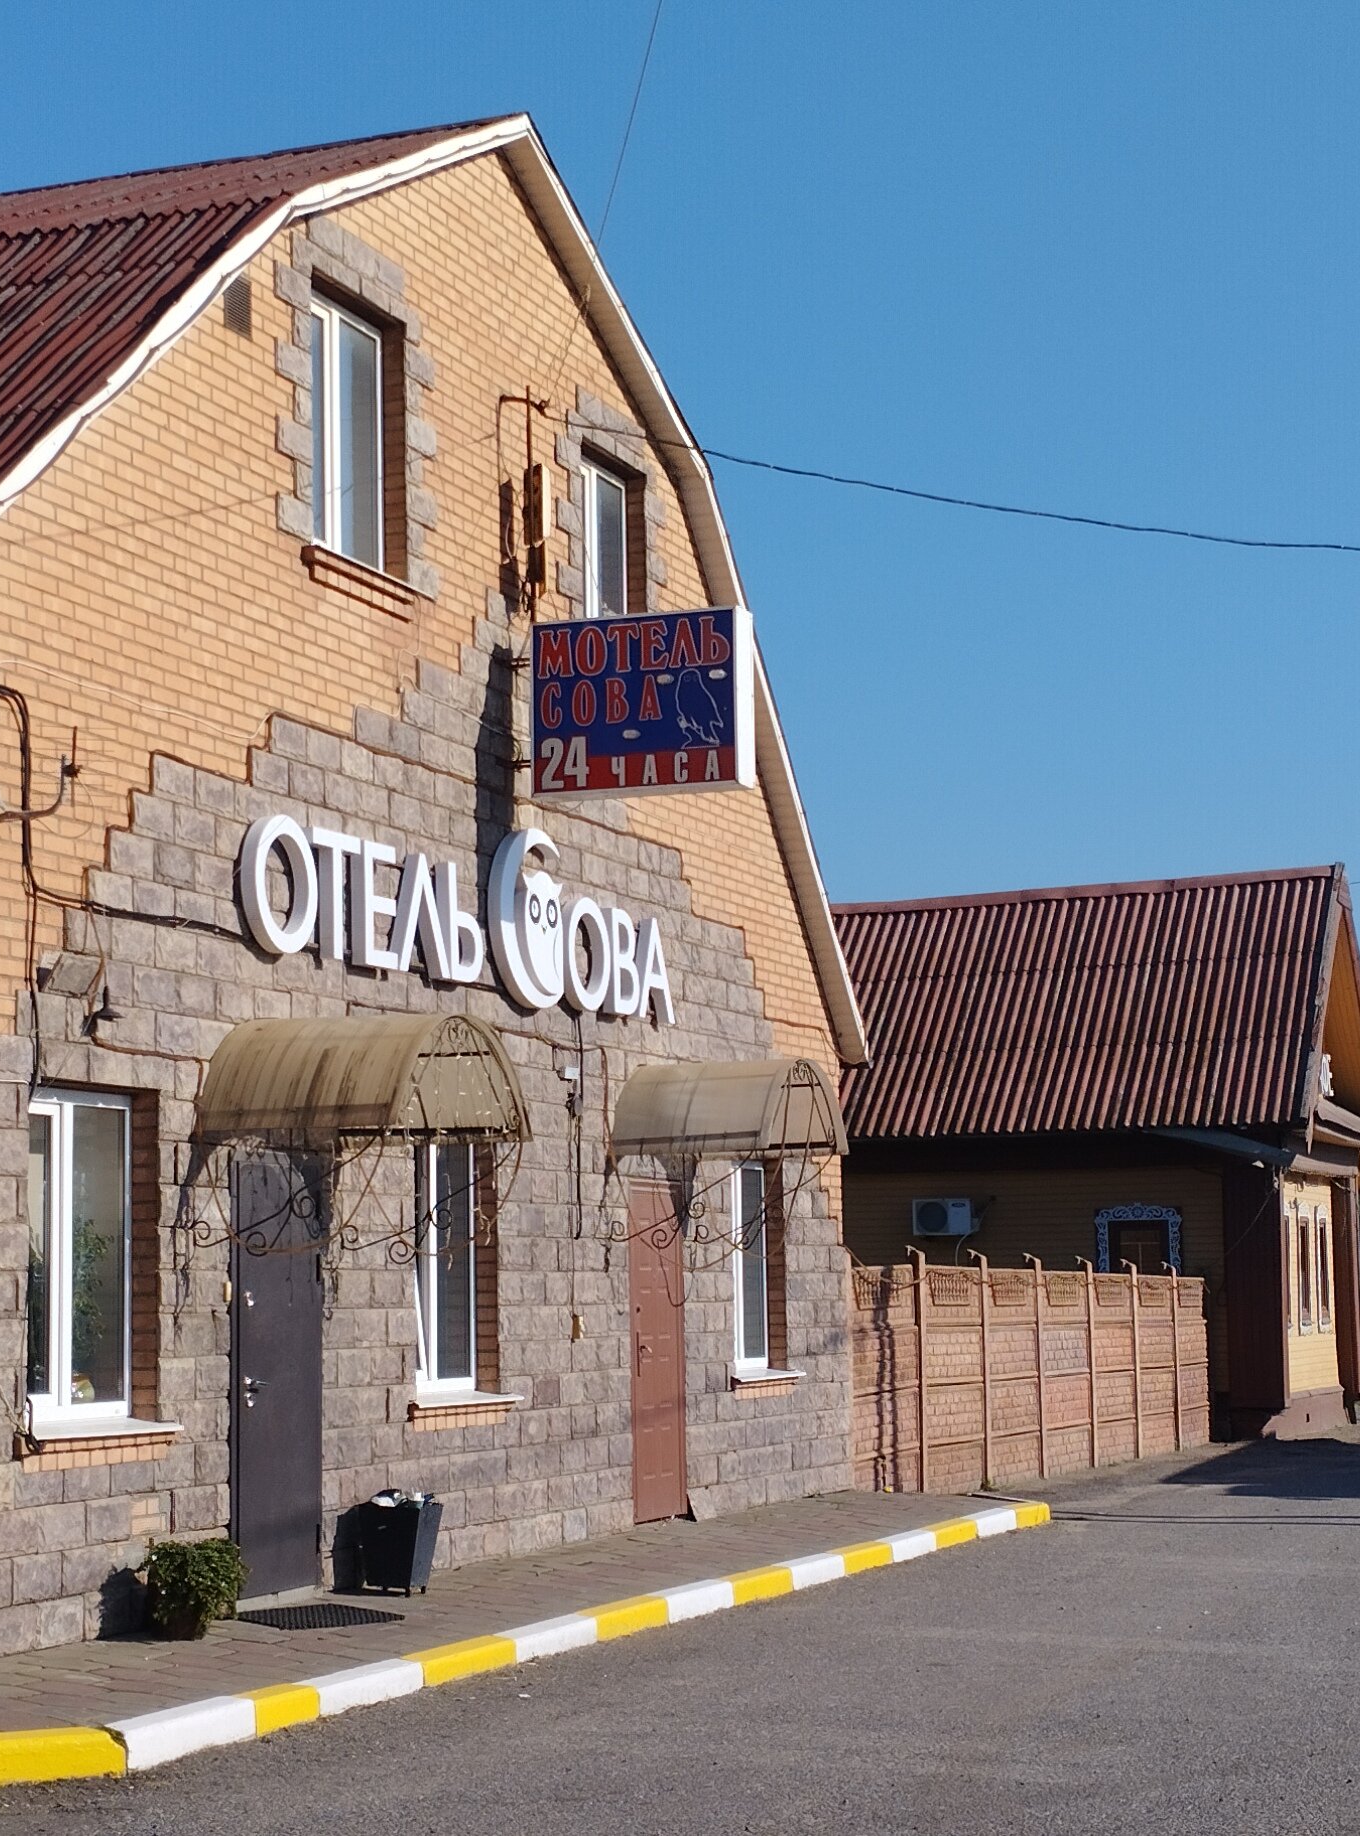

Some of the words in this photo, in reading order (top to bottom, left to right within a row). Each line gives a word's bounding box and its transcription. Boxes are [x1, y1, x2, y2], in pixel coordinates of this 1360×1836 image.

[537, 615, 731, 679] МОТЕЛЬ
[540, 675, 663, 729] СОВА
[541, 736, 590, 790] 24
[611, 750, 721, 787] ЧАСА
[240, 814, 484, 984] ОТЕЛЬ
